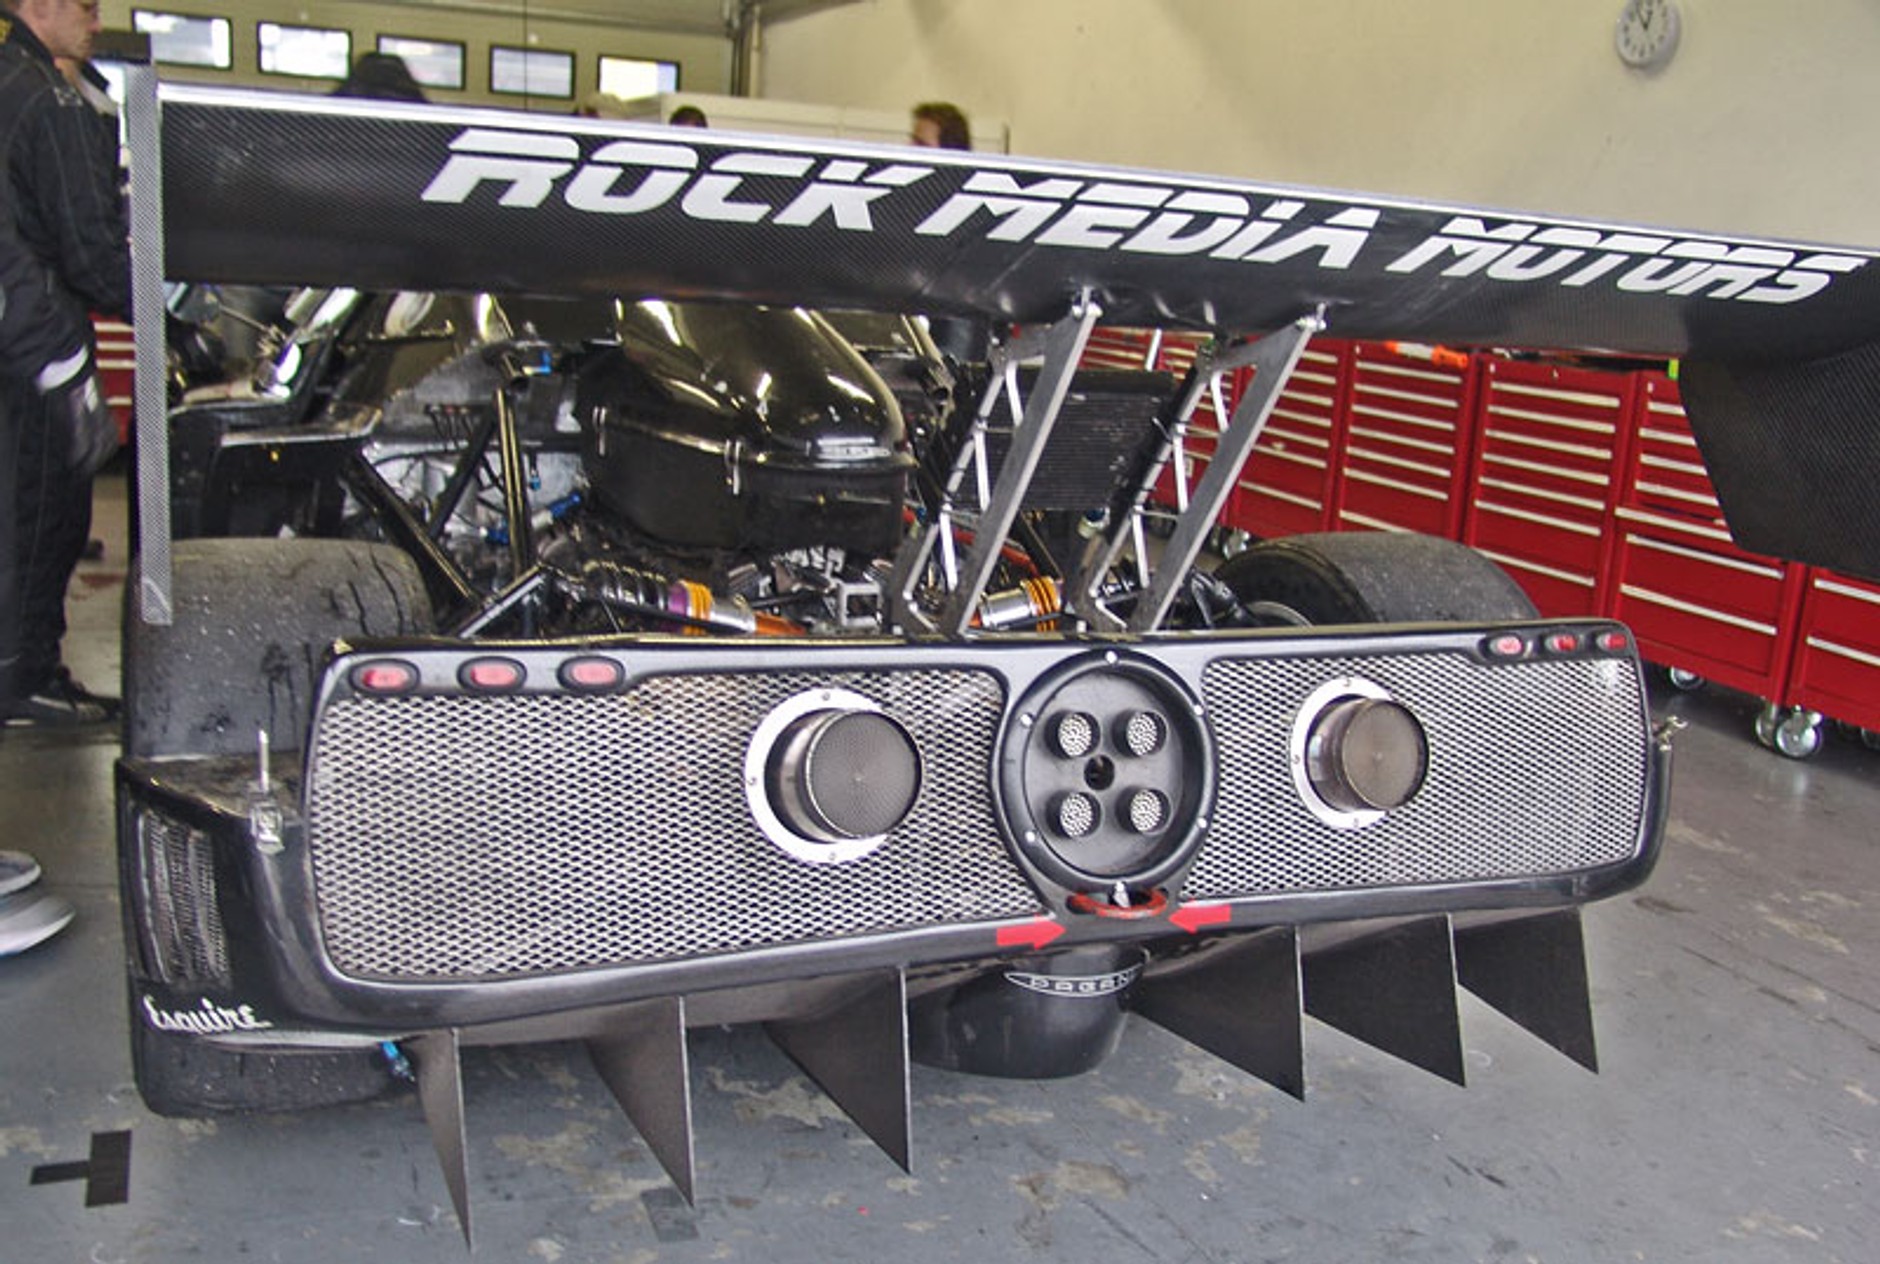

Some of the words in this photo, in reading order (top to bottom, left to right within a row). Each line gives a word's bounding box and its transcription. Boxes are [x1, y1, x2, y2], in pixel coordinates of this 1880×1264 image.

[420, 128, 935, 231] ROCK
[914, 171, 1381, 269] MEDIA
[1385, 216, 1870, 304] MOTORS
[143, 994, 273, 1035] Esquire
